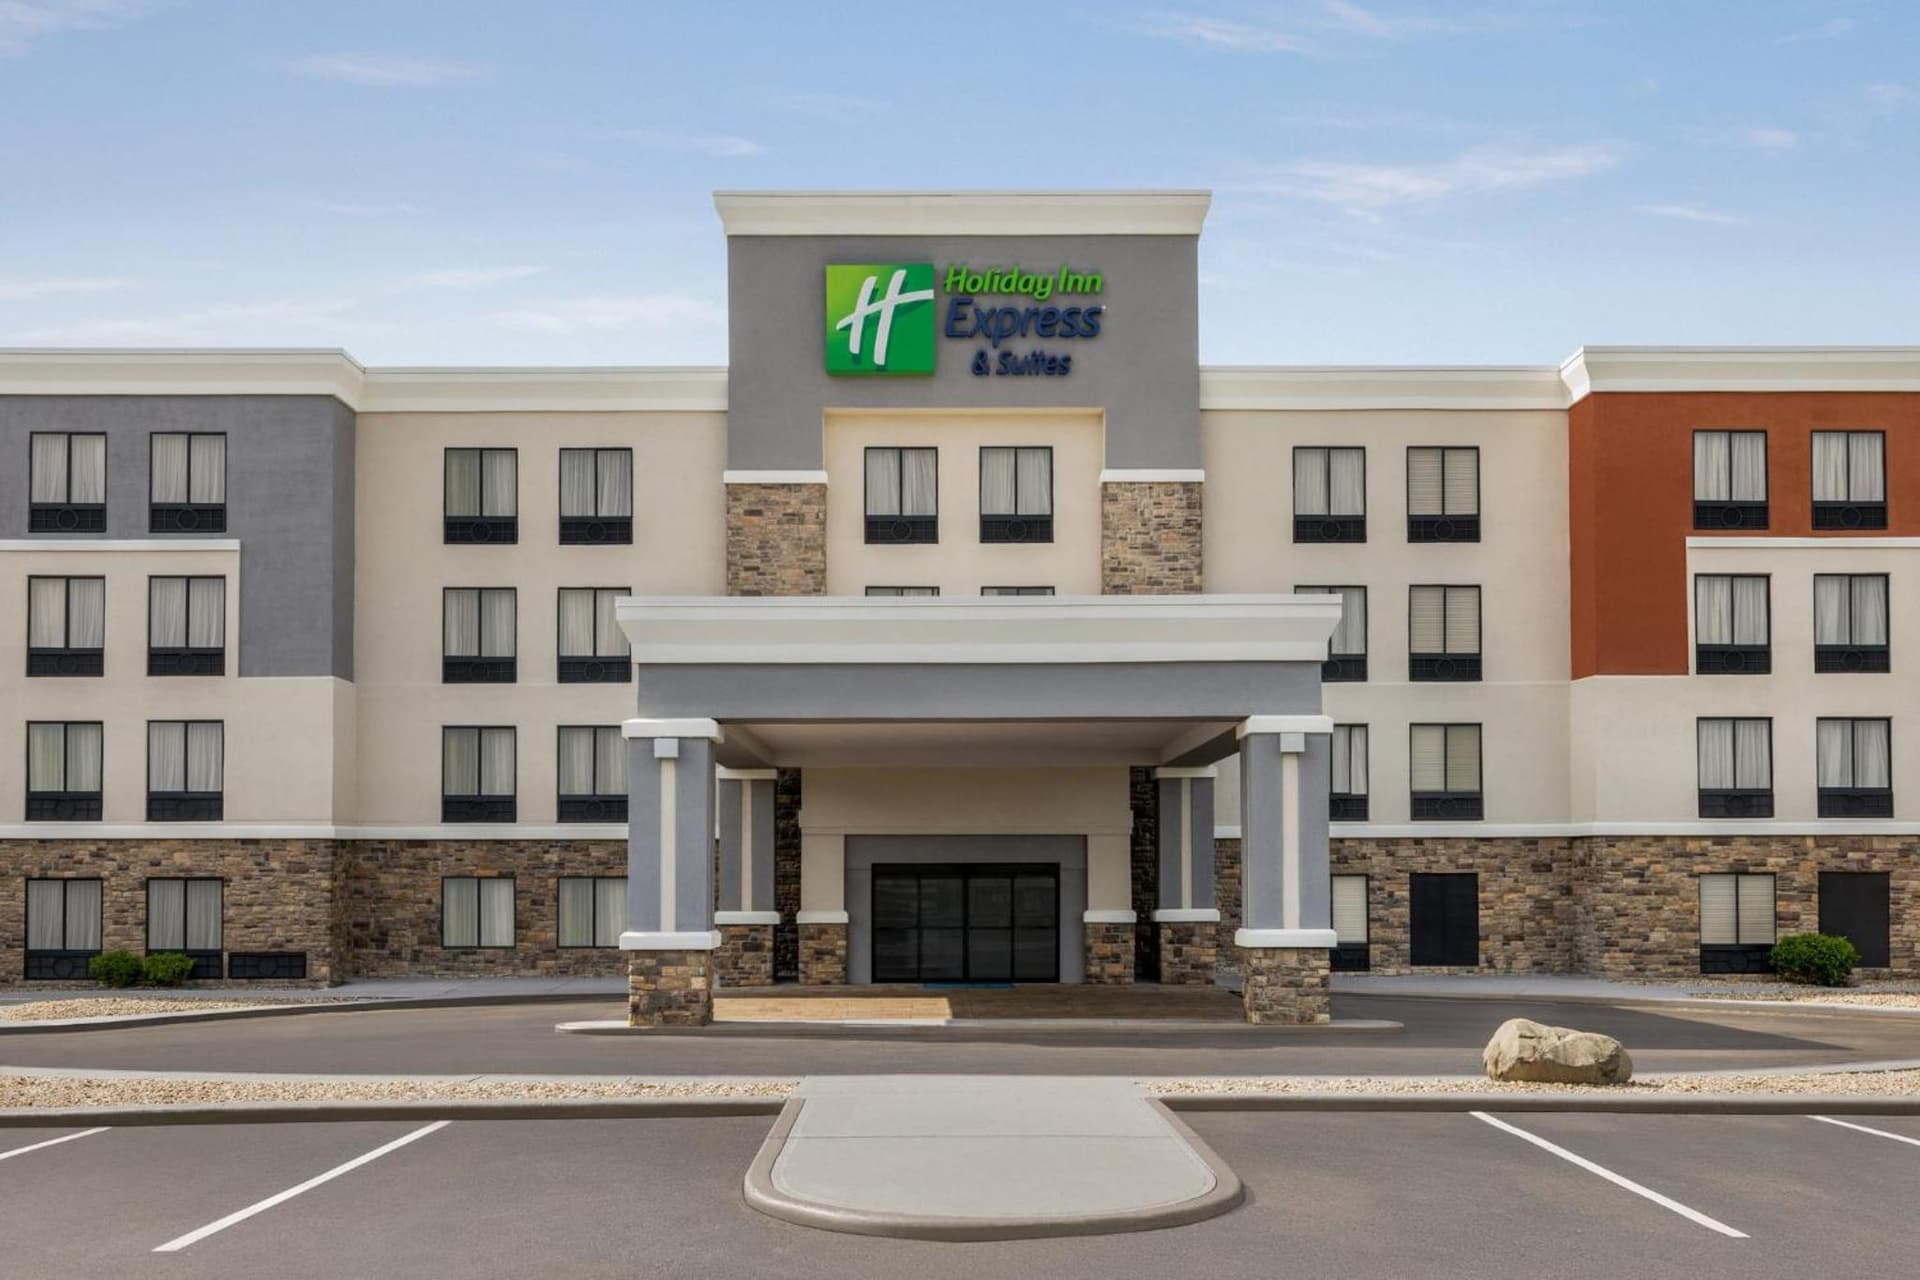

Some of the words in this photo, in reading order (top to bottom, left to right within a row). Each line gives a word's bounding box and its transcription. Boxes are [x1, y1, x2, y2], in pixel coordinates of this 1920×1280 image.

[944, 265, 1053, 299] Holiday
[1058, 265, 1102, 294] Inn
[944, 299, 1102, 349] Express
[972, 351, 990, 376] &
[996, 350, 1072, 376] Suites
